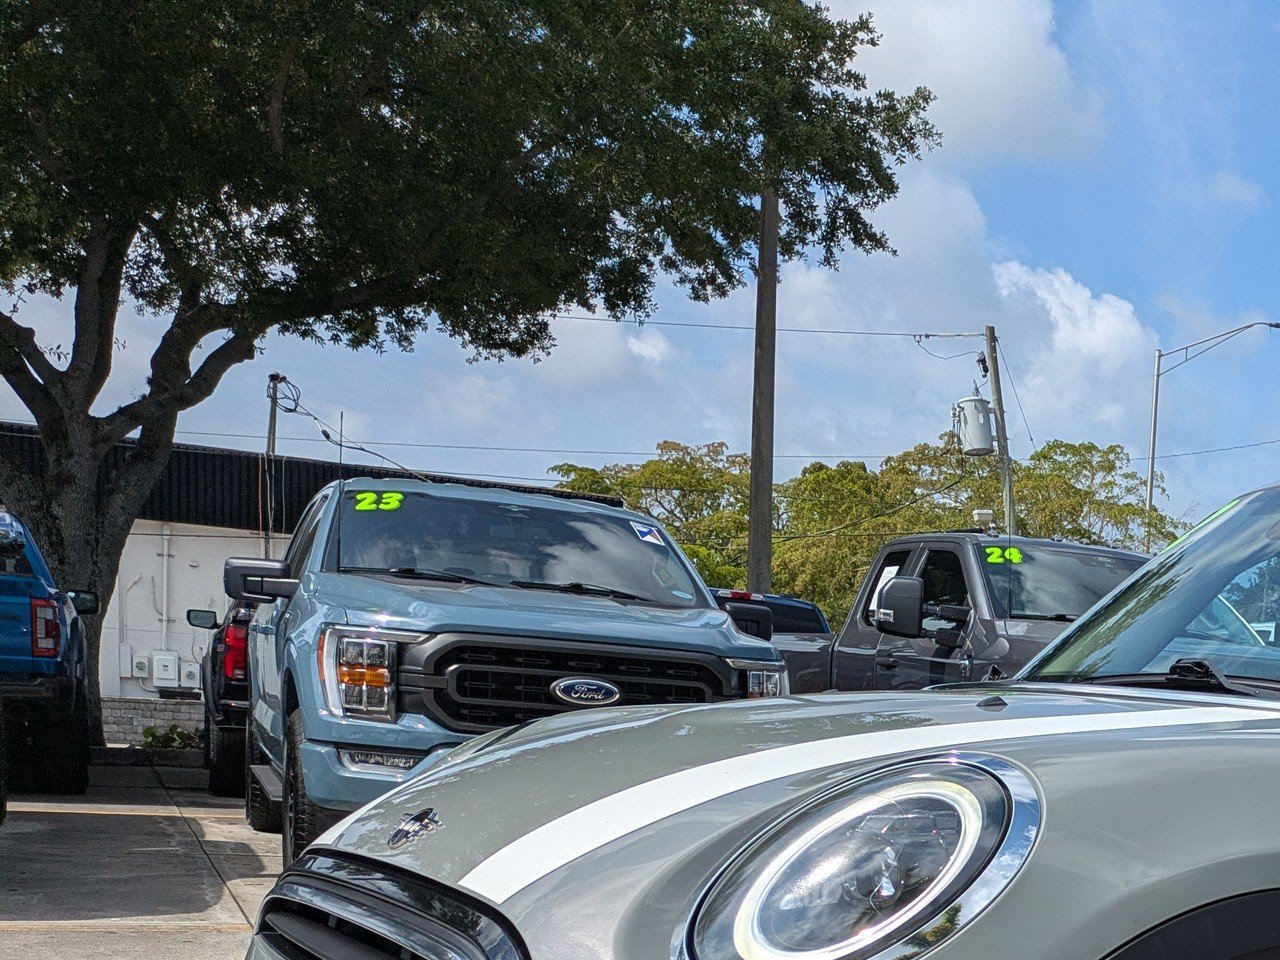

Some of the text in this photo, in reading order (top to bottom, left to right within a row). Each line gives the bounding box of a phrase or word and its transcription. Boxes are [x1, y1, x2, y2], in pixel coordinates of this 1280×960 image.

[355, 492, 404, 511] 23
[985, 547, 1023, 564] 24
[571, 684, 606, 700] Ford
